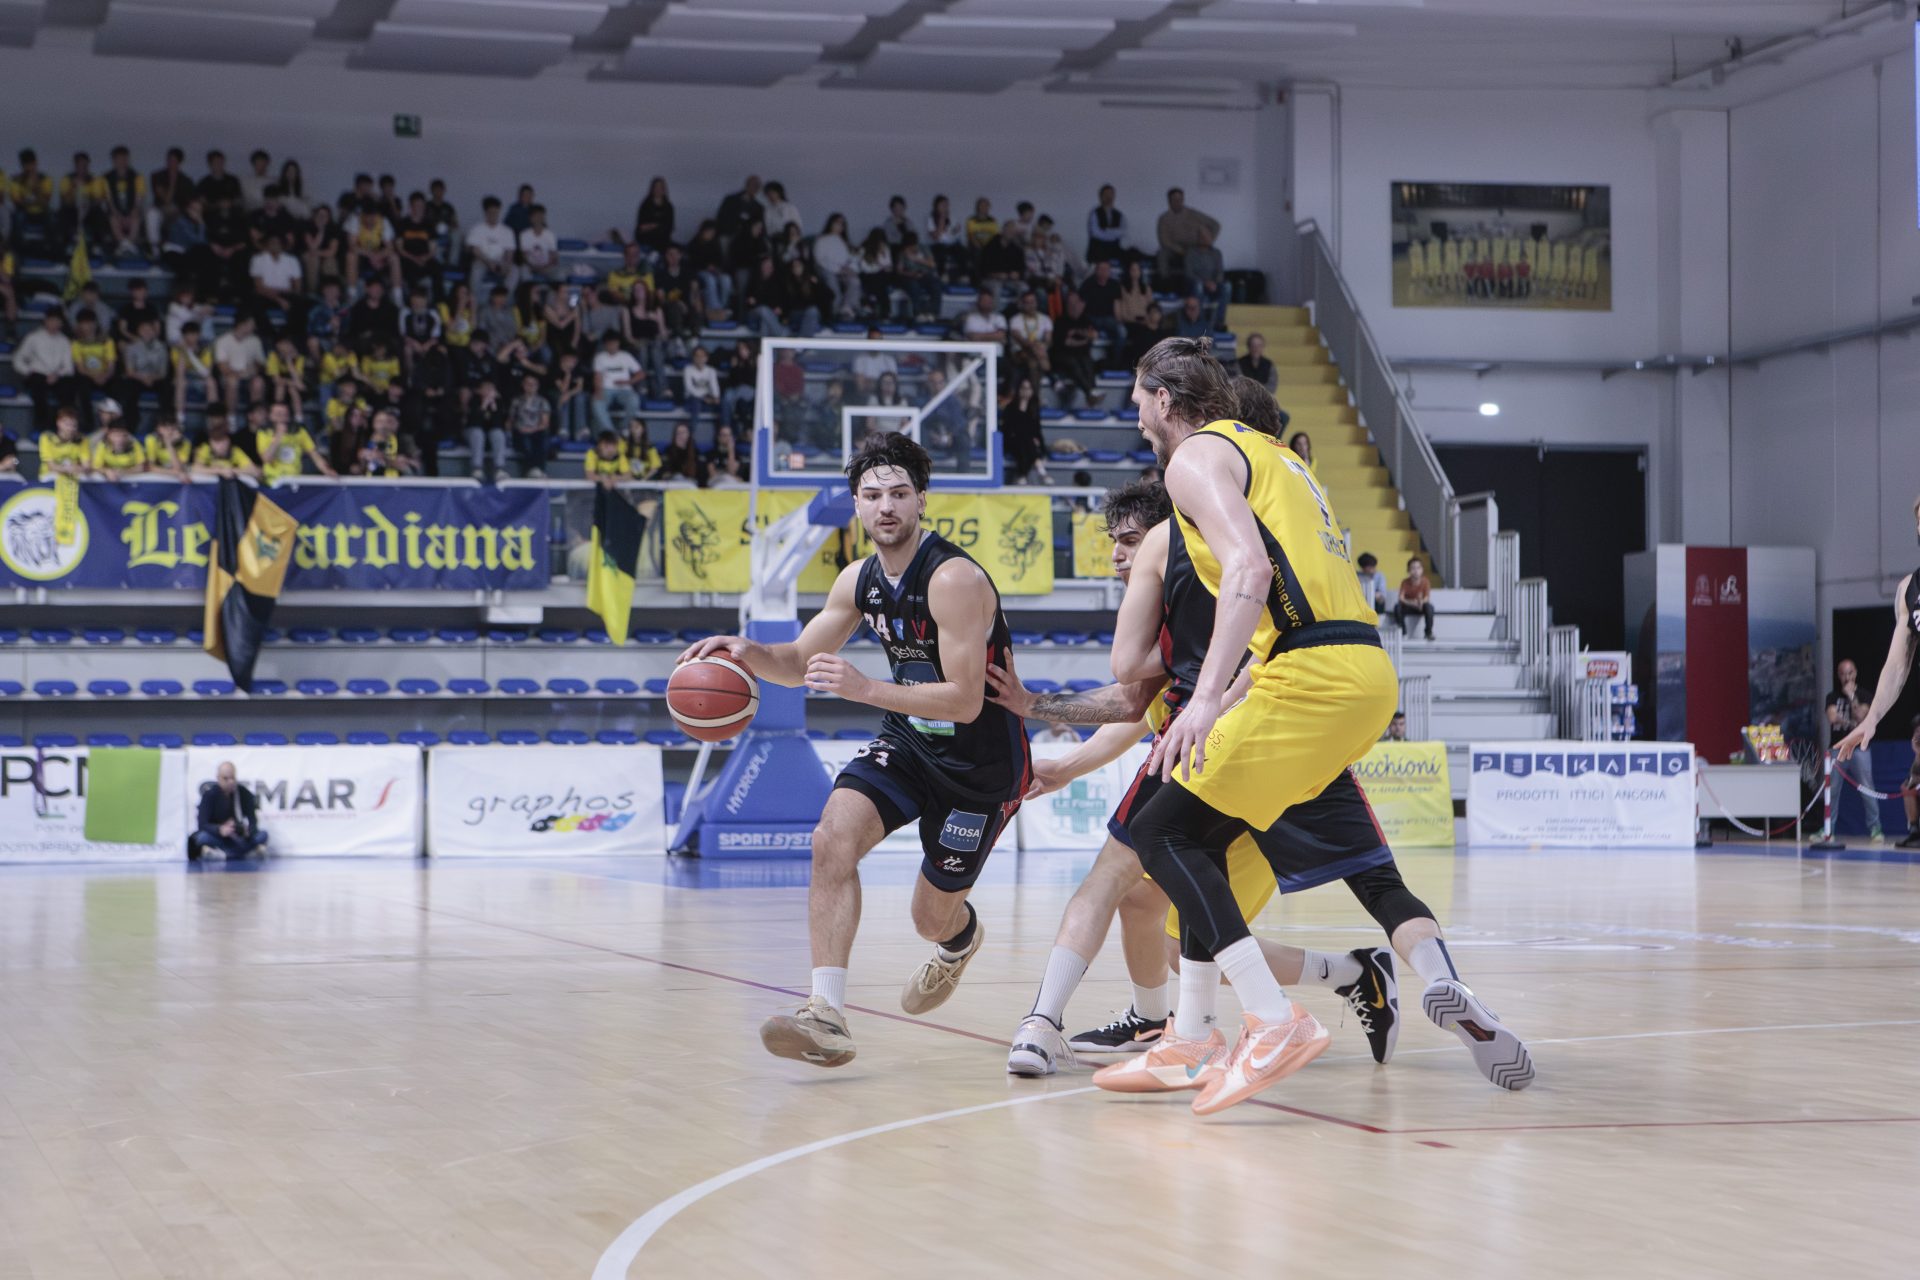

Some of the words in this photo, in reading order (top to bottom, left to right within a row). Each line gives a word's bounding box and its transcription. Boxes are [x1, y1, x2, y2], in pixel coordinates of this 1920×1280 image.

[121, 501, 536, 570] Leardiana
[1352, 753, 1442, 778] acchioni
[1477, 755, 1686, 775] PESKATO
[1496, 789, 1560, 801] PRODOTTI
[1569, 789, 1605, 801] ITTICI
[1614, 789, 1667, 801] ANCONA
[462, 786, 635, 826] graphos
[945, 823, 980, 838] STOSA
[718, 832, 813, 851] SPORTSYST
